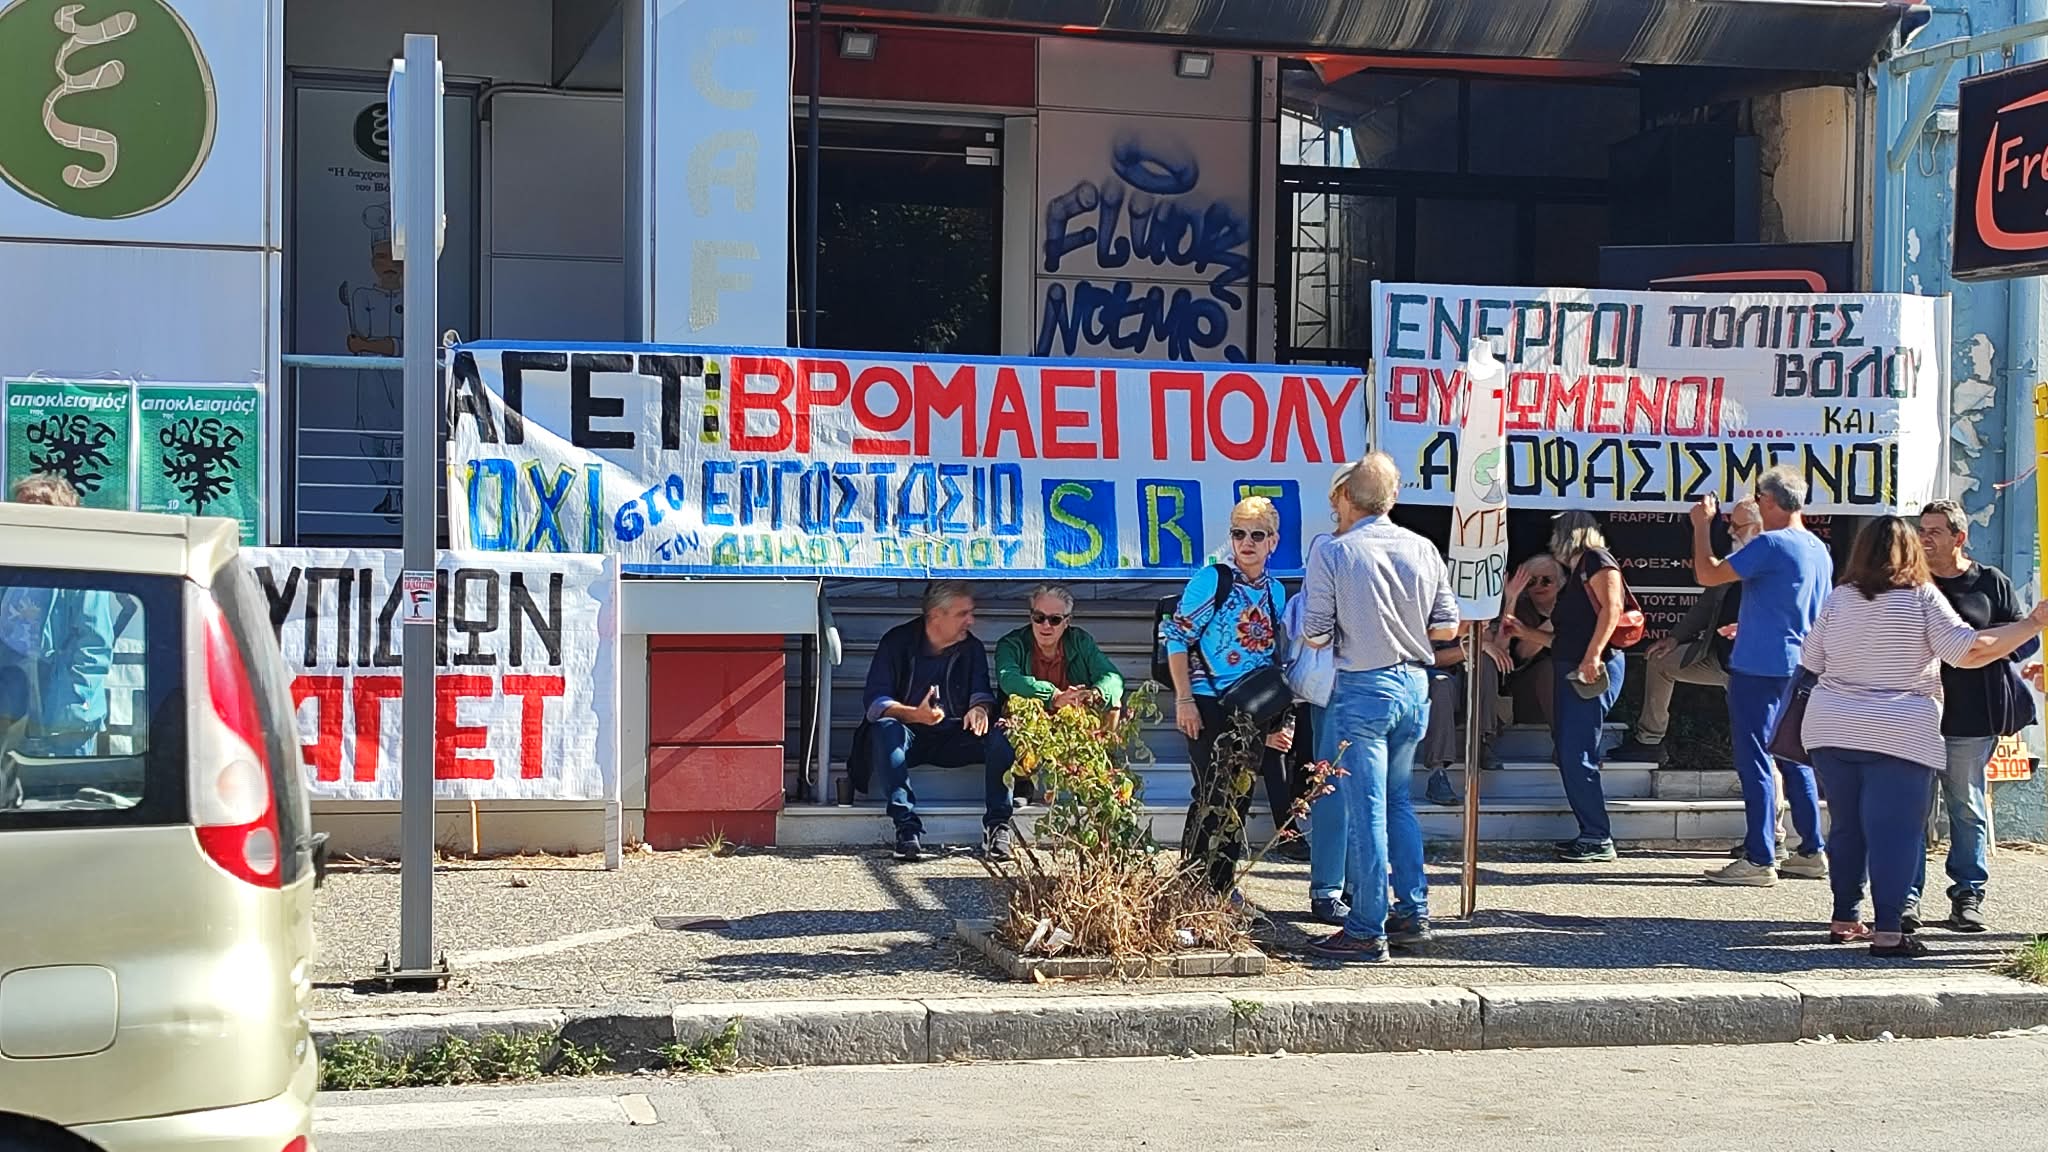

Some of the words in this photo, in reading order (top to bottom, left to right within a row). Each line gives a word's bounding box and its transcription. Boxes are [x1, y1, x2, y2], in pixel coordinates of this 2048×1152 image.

[1384, 292, 1643, 368] ΕΝΕΡΓΟΙ
[1668, 303, 1865, 348] ΠΟΛΙΤΕΣ
[1773, 346, 1921, 398] ΒΟΛΟΥ
[10, 391, 127, 413] αποκλεισμός!
[141, 395, 256, 414] αποκλεισμός!
[729, 356, 1119, 460] ΒΡΩΜΑΕΙ
[1149, 371, 1361, 463] ΠΟΛΥ
[465, 458, 603, 553] ΟΧΙ
[702, 459, 1023, 538] ΕΡΓΟΣΤΑΣΙΟ
[1610, 511, 1666, 523] FRAPPE
[655, 530, 699, 561] του
[254, 567, 564, 667] ΥΠΙΔΙΩΝ
[1641, 594, 1677, 606] ΤΟΥΣ
[290, 674, 566, 782] ΑΓΕΤ
[1986, 757, 2030, 779] STOP
